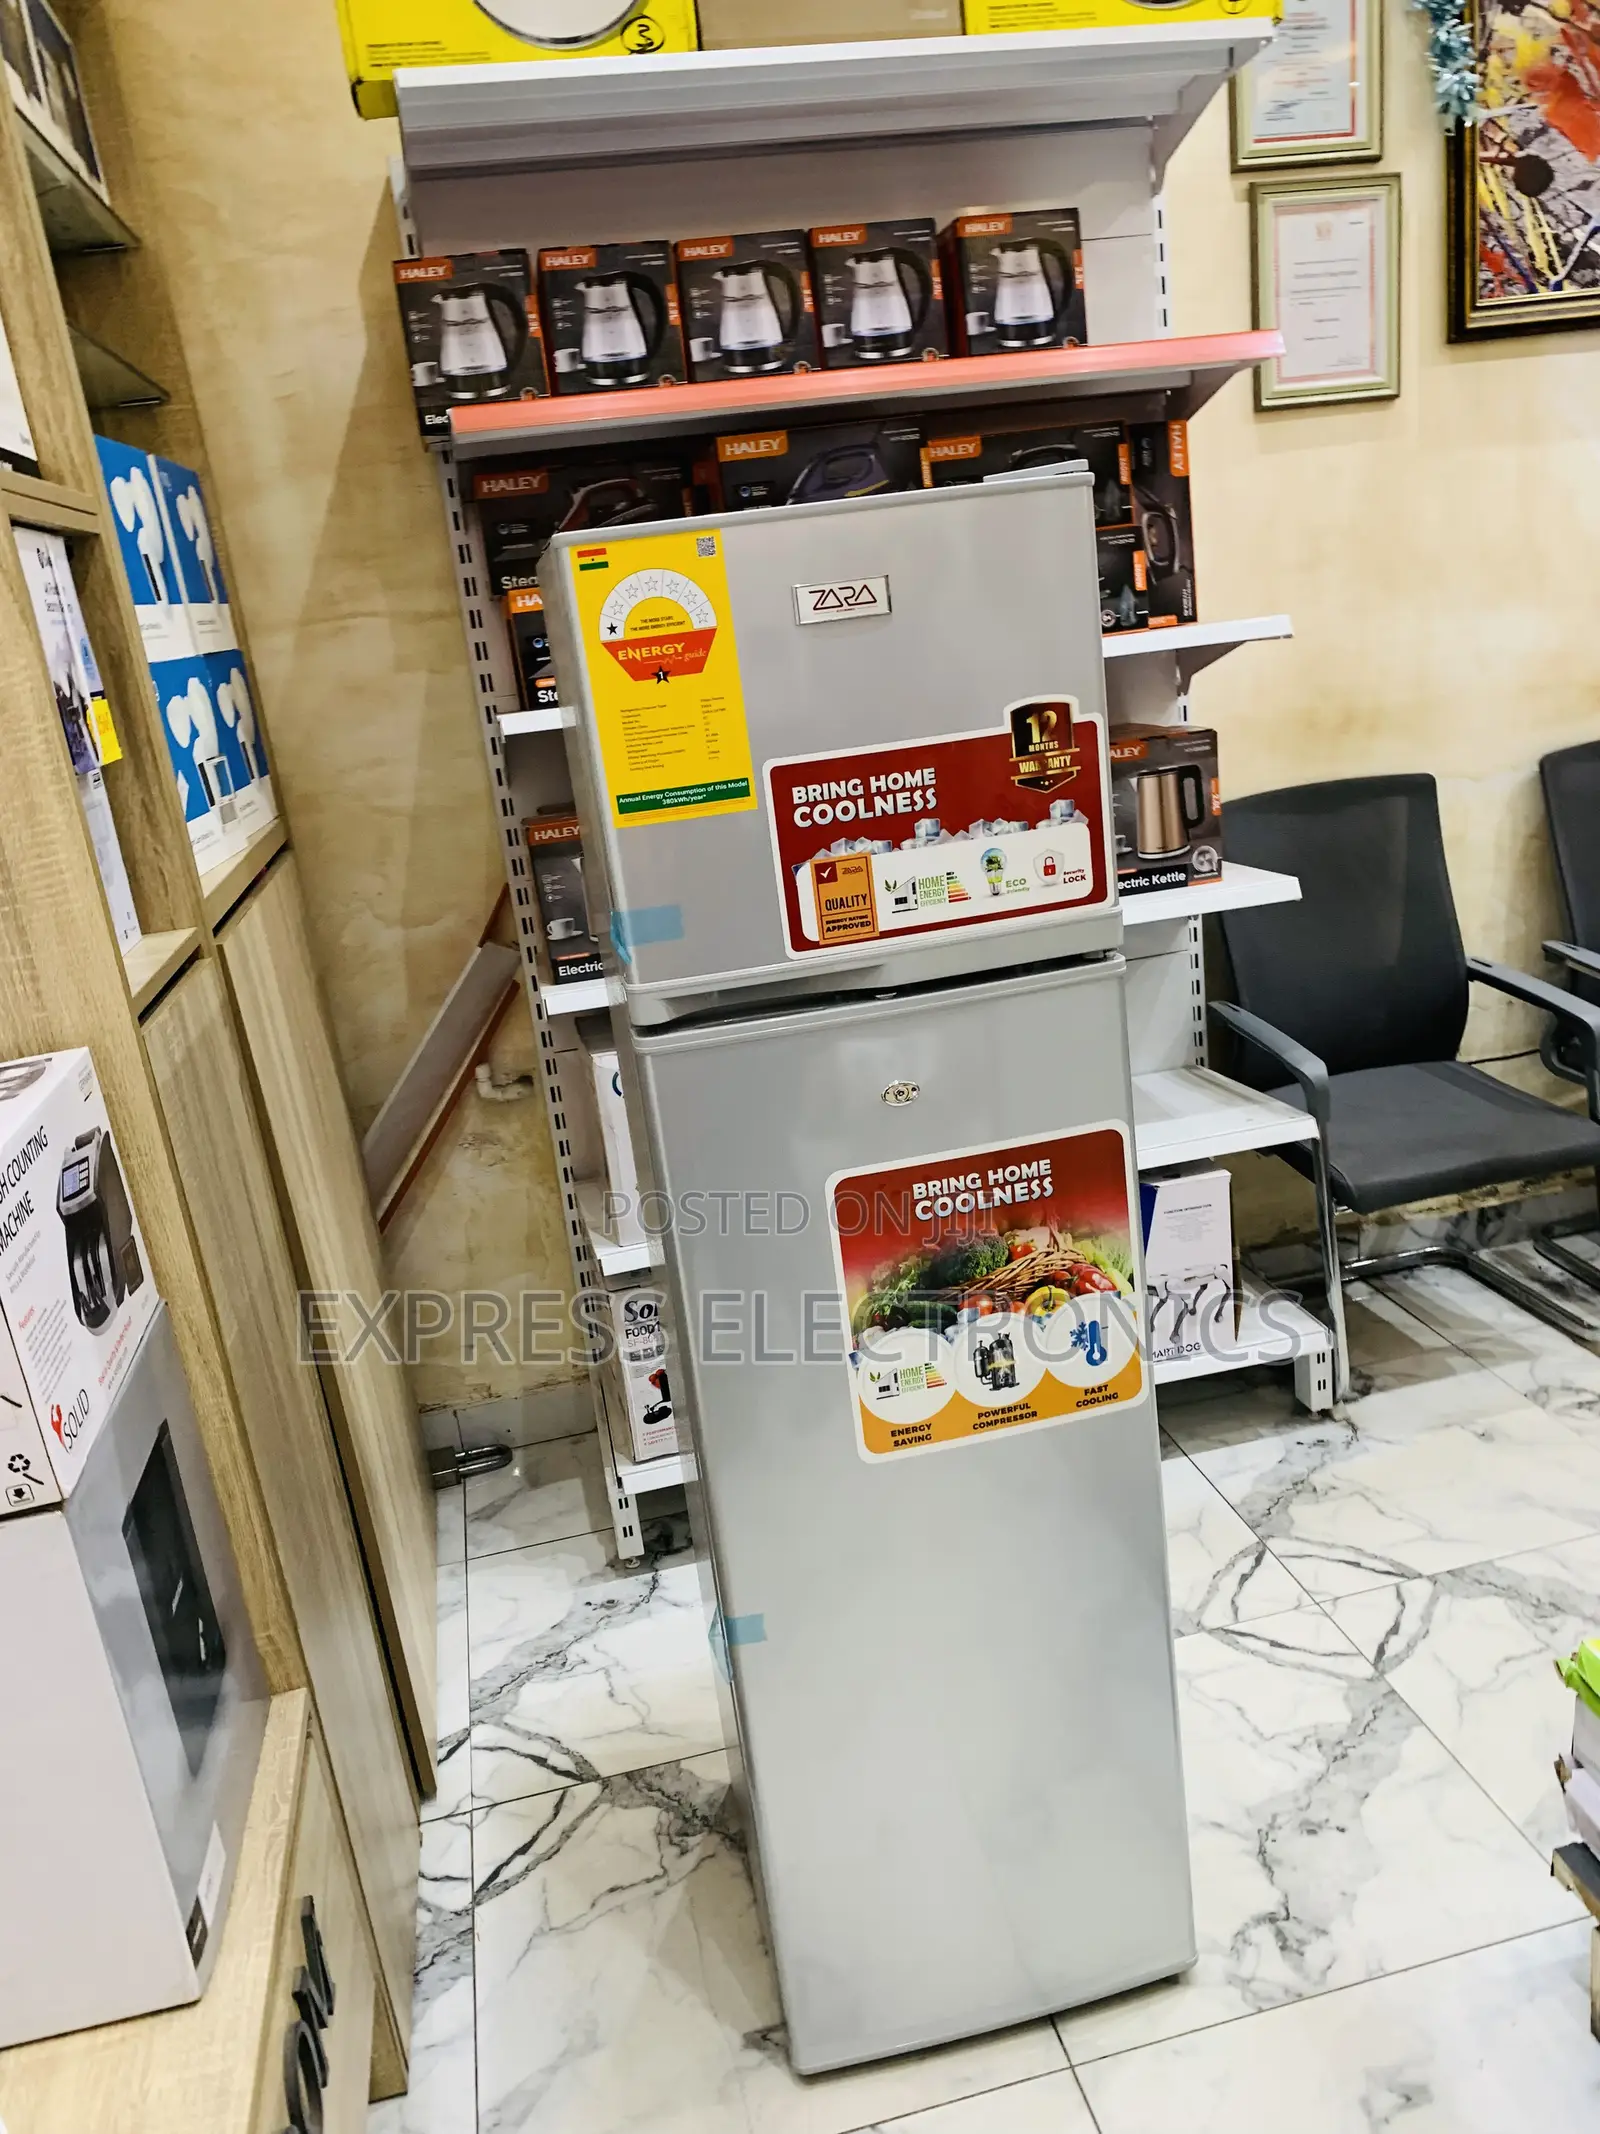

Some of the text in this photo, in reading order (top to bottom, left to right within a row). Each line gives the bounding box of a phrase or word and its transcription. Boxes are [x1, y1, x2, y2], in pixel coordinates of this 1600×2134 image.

[818, 230, 862, 244] HALEY
[683, 243, 728, 258] HALEY
[545, 252, 590, 267] HALEY
[399, 265, 446, 280] HALEY
[725, 438, 780, 456] HALEY
[930, 441, 977, 457] HALEY
[1171, 424, 1185, 472] HALEY
[481, 474, 541, 493] HALEY
[808, 584, 877, 610] ZARA
[617, 642, 685, 662] ENERGY
[1026, 710, 1058, 744] 12
[1028, 741, 1059, 752] MONTHS
[619, 795, 642, 804] Annual
[642, 792, 664, 801] Energy
[664, 786, 707, 799] Consumption
[715, 782, 727, 791] this
[728, 780, 748, 789] Model
[792, 767, 936, 804] BRING HOME
[793, 787, 937, 828] COOLNESS
[534, 825, 580, 841] HALEY
[918, 874, 945, 890] HOME
[1005, 878, 1027, 888] ECO
[1063, 874, 1087, 885] LOCK
[1151, 871, 1187, 886] Kettle
[825, 893, 868, 911] QUALITY
[919, 888, 946, 900] ENERGY
[825, 920, 871, 933] APPROVED
[7, 1124, 48, 1188] COUNTING
[912, 1158, 1052, 1200] BRING HOME
[914, 1177, 1054, 1221] COOLNESS
[1177, 1342, 1201, 1355] DOG
[899, 1365, 923, 1380] HOME
[1084, 1384, 1109, 1396] FAST
[1076, 1392, 1119, 1408] COOLING
[63, 1388, 90, 1450] SOLID
[977, 1402, 1031, 1420] POWERFUL
[972, 1410, 1038, 1430] COMPRESSOR
[890, 1423, 932, 1438] ENERGY
[893, 1433, 932, 1447] SAVING
